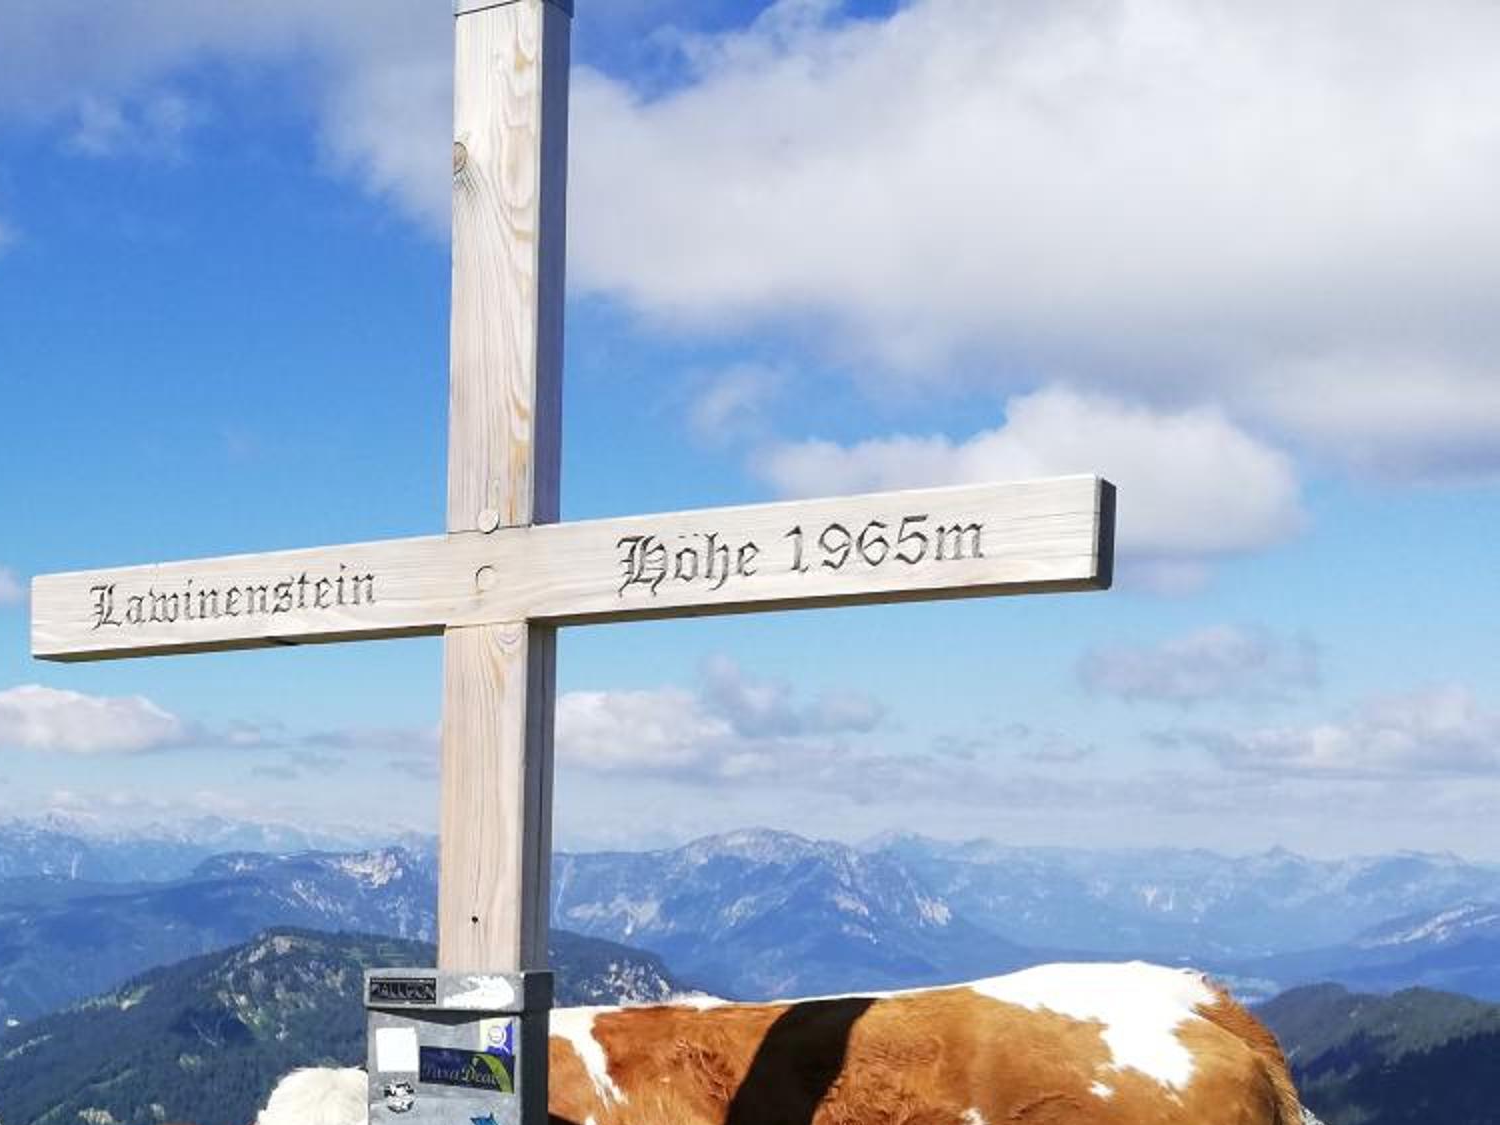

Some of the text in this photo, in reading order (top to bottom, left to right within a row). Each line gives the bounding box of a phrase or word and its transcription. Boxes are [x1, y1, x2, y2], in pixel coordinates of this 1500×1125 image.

[89, 513, 985, 630] Lawinenstein Höhe 1965m
